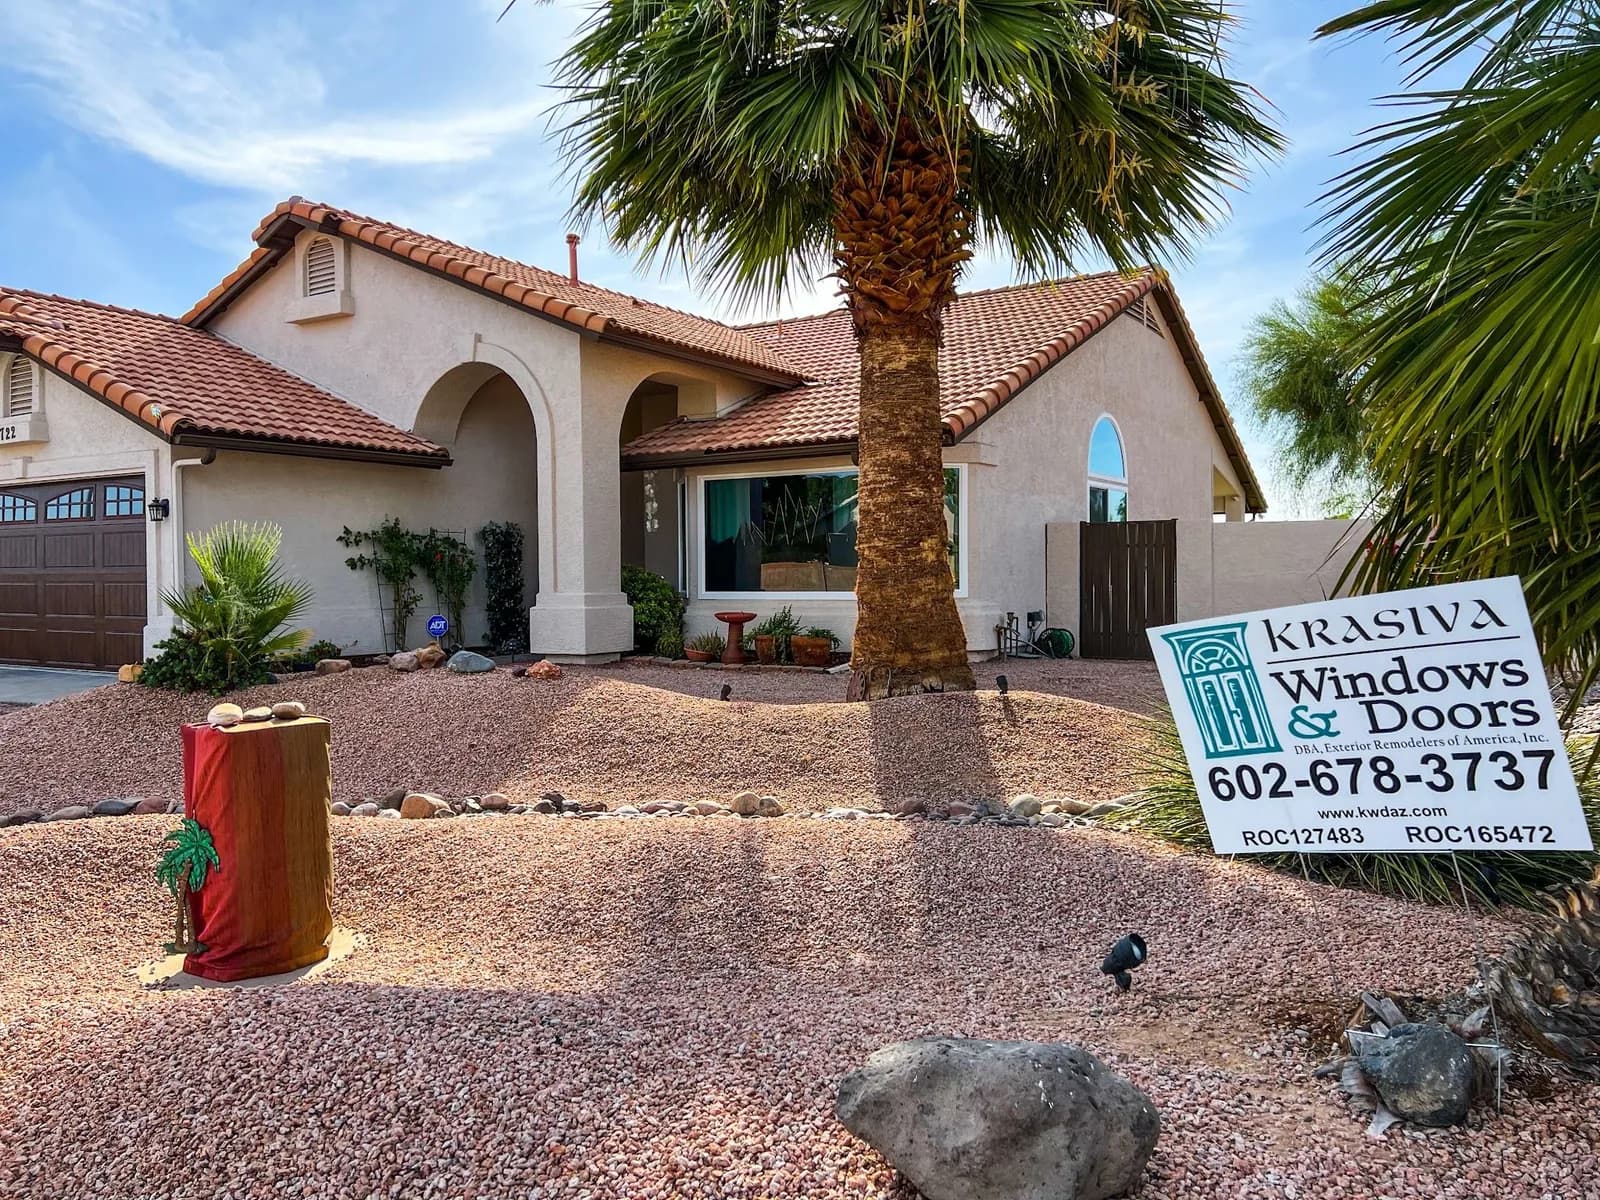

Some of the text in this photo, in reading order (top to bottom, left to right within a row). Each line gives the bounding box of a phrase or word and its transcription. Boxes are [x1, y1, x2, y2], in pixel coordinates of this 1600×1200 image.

[430, 620, 446, 629] ADT
[1263, 599, 1508, 652] KRASIVA
[1269, 656, 1529, 703] Windows
[1288, 698, 1541, 739] & Doors
[1325, 740, 1372, 753] Exterior
[1373, 737, 1445, 750] Remodelers
[1447, 735, 1461, 746] of
[1463, 733, 1522, 747] America,
[1522, 732, 1550, 743] Inc.
[1208, 749, 1556, 801] 602-678-3737
[1318, 805, 1448, 820] www.kwdaz.com
[1242, 825, 1556, 847] ROC127483 ROC165472
